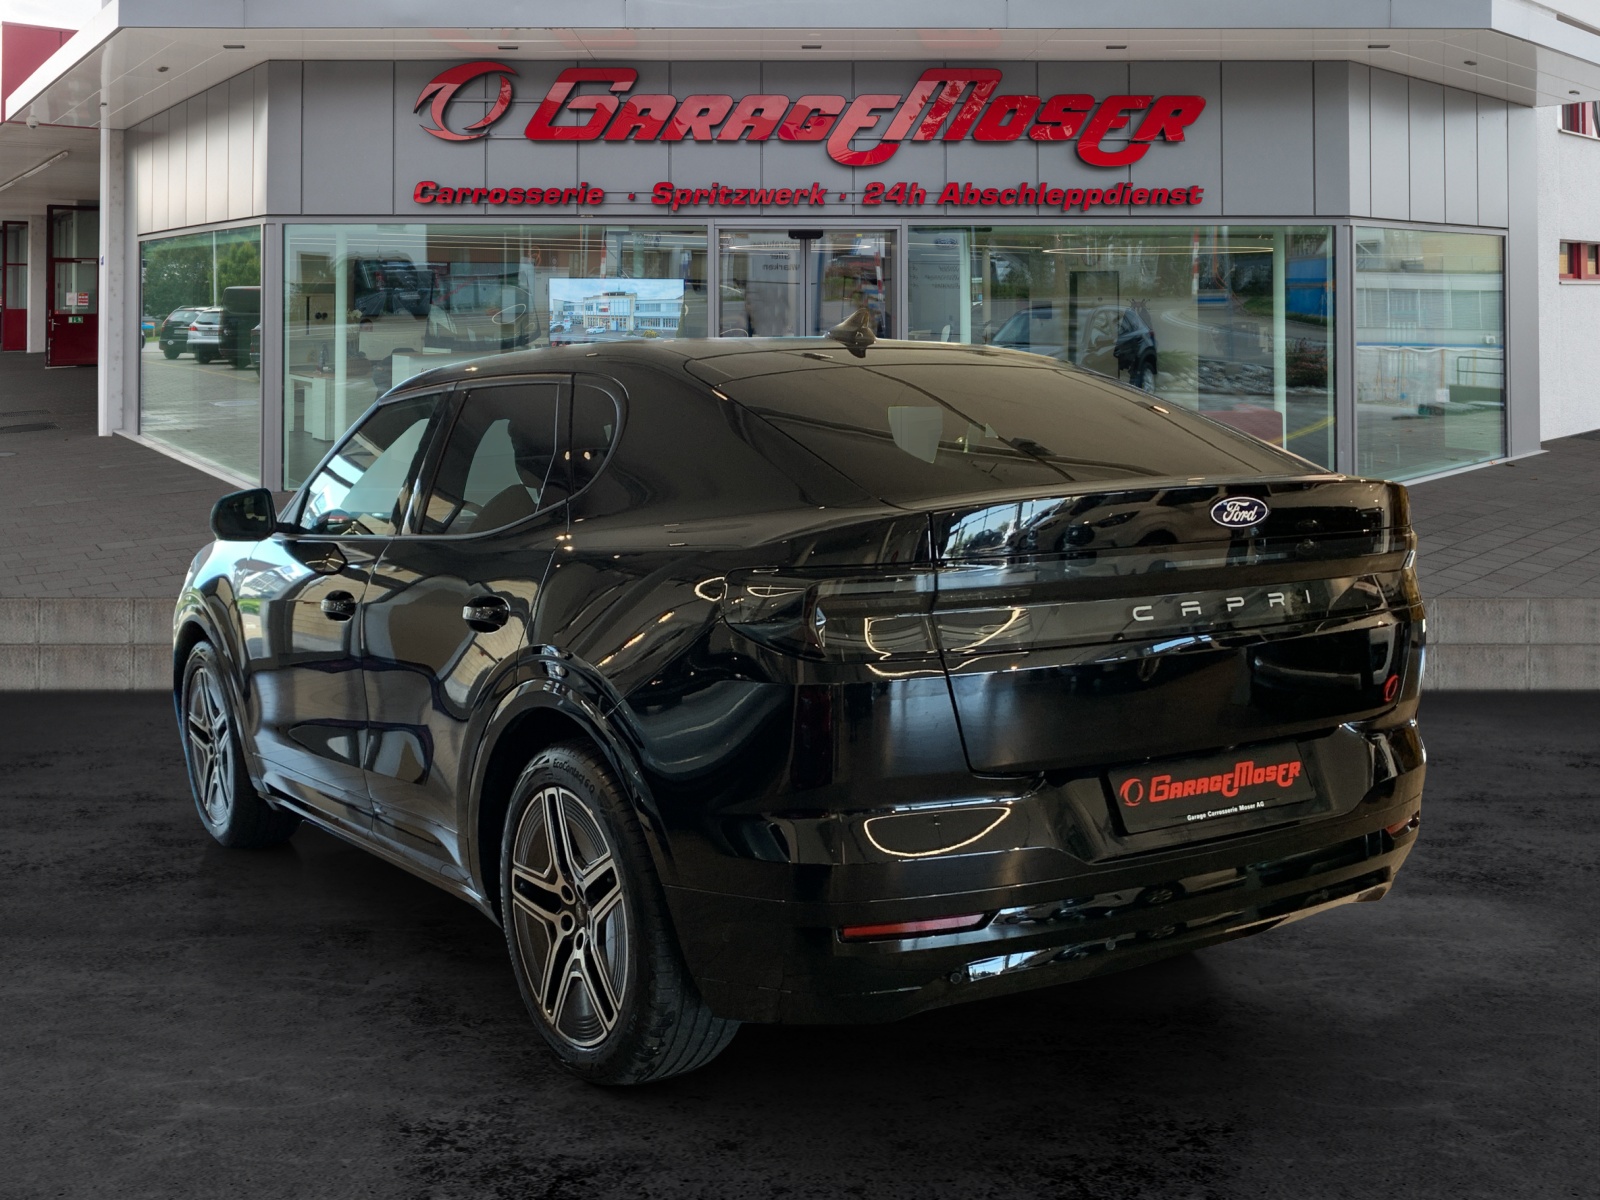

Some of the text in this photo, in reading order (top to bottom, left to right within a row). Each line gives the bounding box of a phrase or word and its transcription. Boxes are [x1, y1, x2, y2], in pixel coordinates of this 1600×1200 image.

[413, 180, 1204, 211] Carrosserie Spritzwerk 24h Abschleppdienst
[1222, 501, 1258, 522] Ford
[1132, 589, 1311, 621] CAPRI
[1207, 806, 1238, 817] Carrosserie
[1238, 803, 1256, 812] Moser
